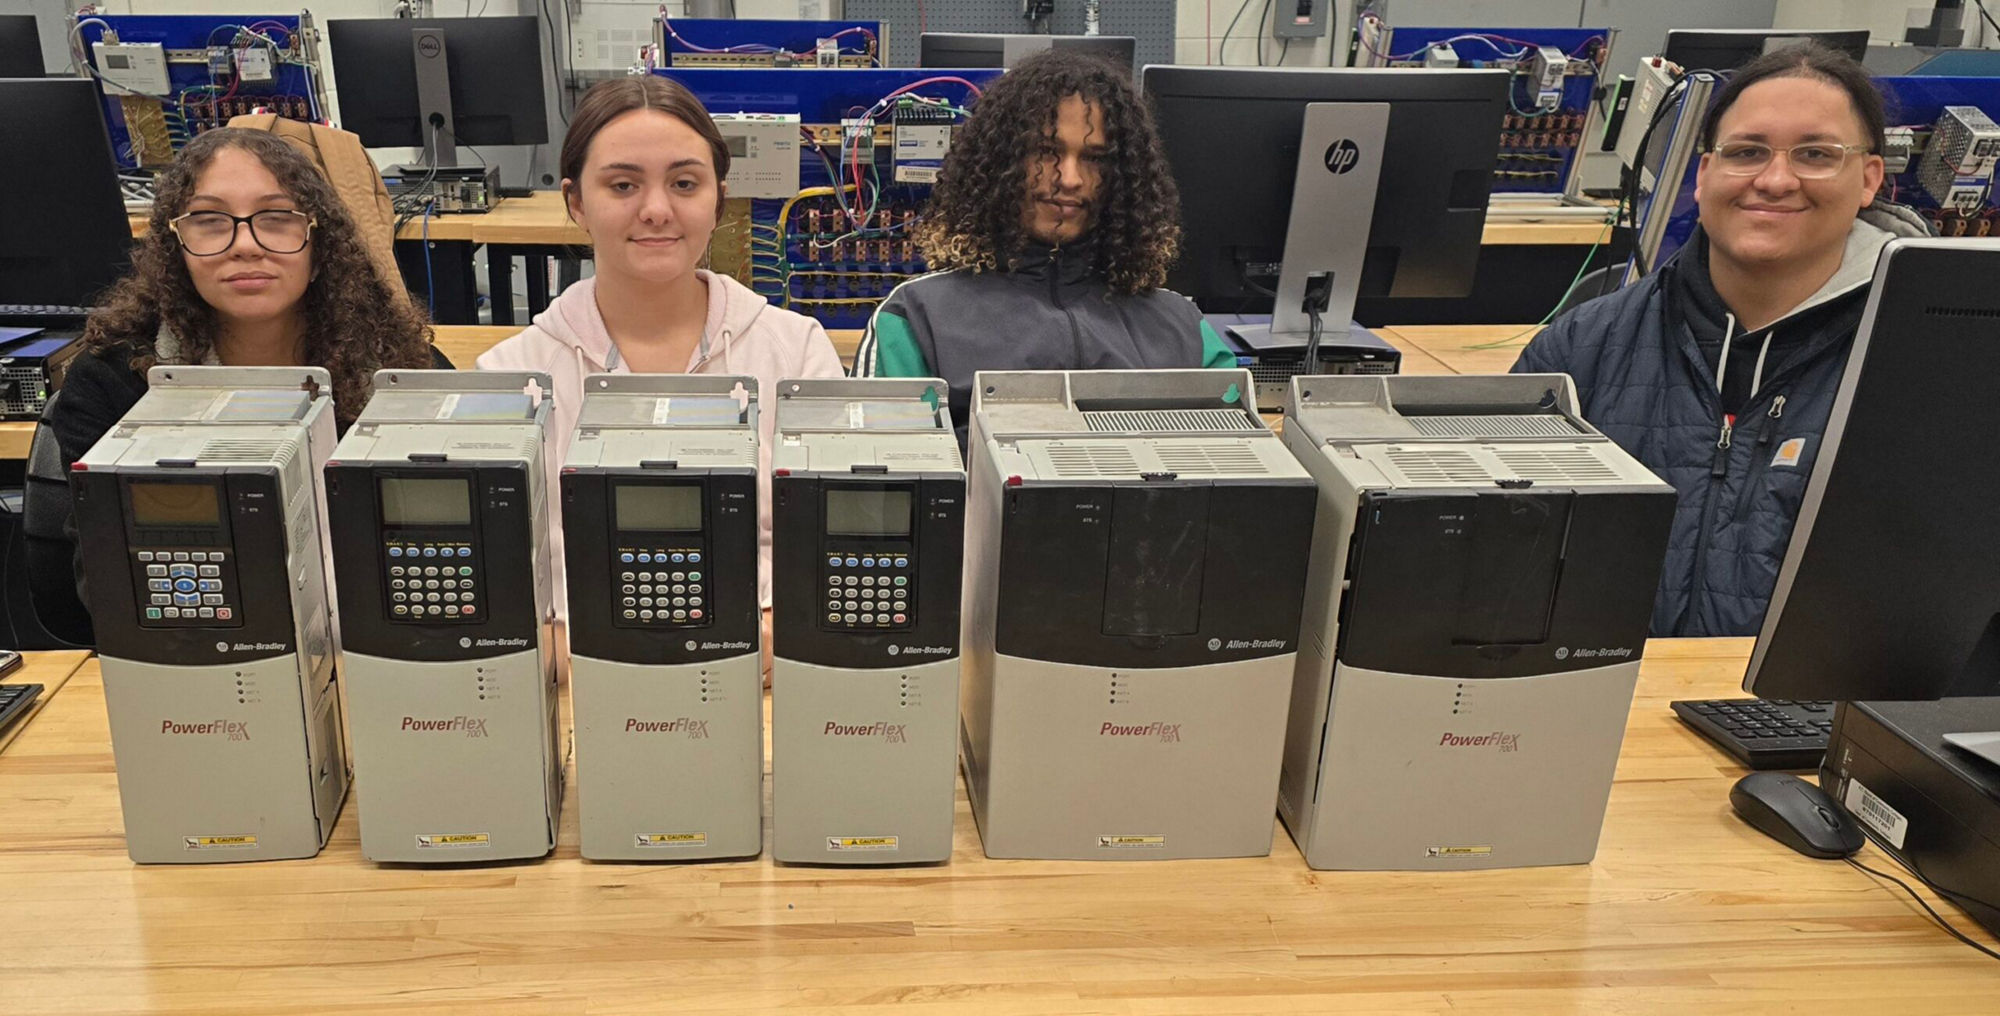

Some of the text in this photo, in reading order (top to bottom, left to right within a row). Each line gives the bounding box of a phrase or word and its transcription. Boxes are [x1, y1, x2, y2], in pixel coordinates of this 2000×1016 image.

[1327, 139, 1357, 174] hp
[233, 642, 286, 651] Allen-Bradley
[476, 638, 528, 647] Allen-Bradley
[701, 641, 751, 650] Allen-Bradley
[1226, 639, 1286, 649] Allen-Bradley
[902, 646, 952, 654] Allen-Bradley
[1573, 647, 1632, 657] Allen-Bradley
[161, 720, 250, 740] PowerFlex
[401, 716, 488, 737] PowerFlex
[625, 718, 709, 738] PowerFlex
[466, 730, 481, 738] 700
[688, 731, 702, 739] 700
[824, 721, 906, 743] PowerFlex
[1100, 722, 1181, 742] PowerFlex
[1439, 732, 1521, 751] PowerFlex
